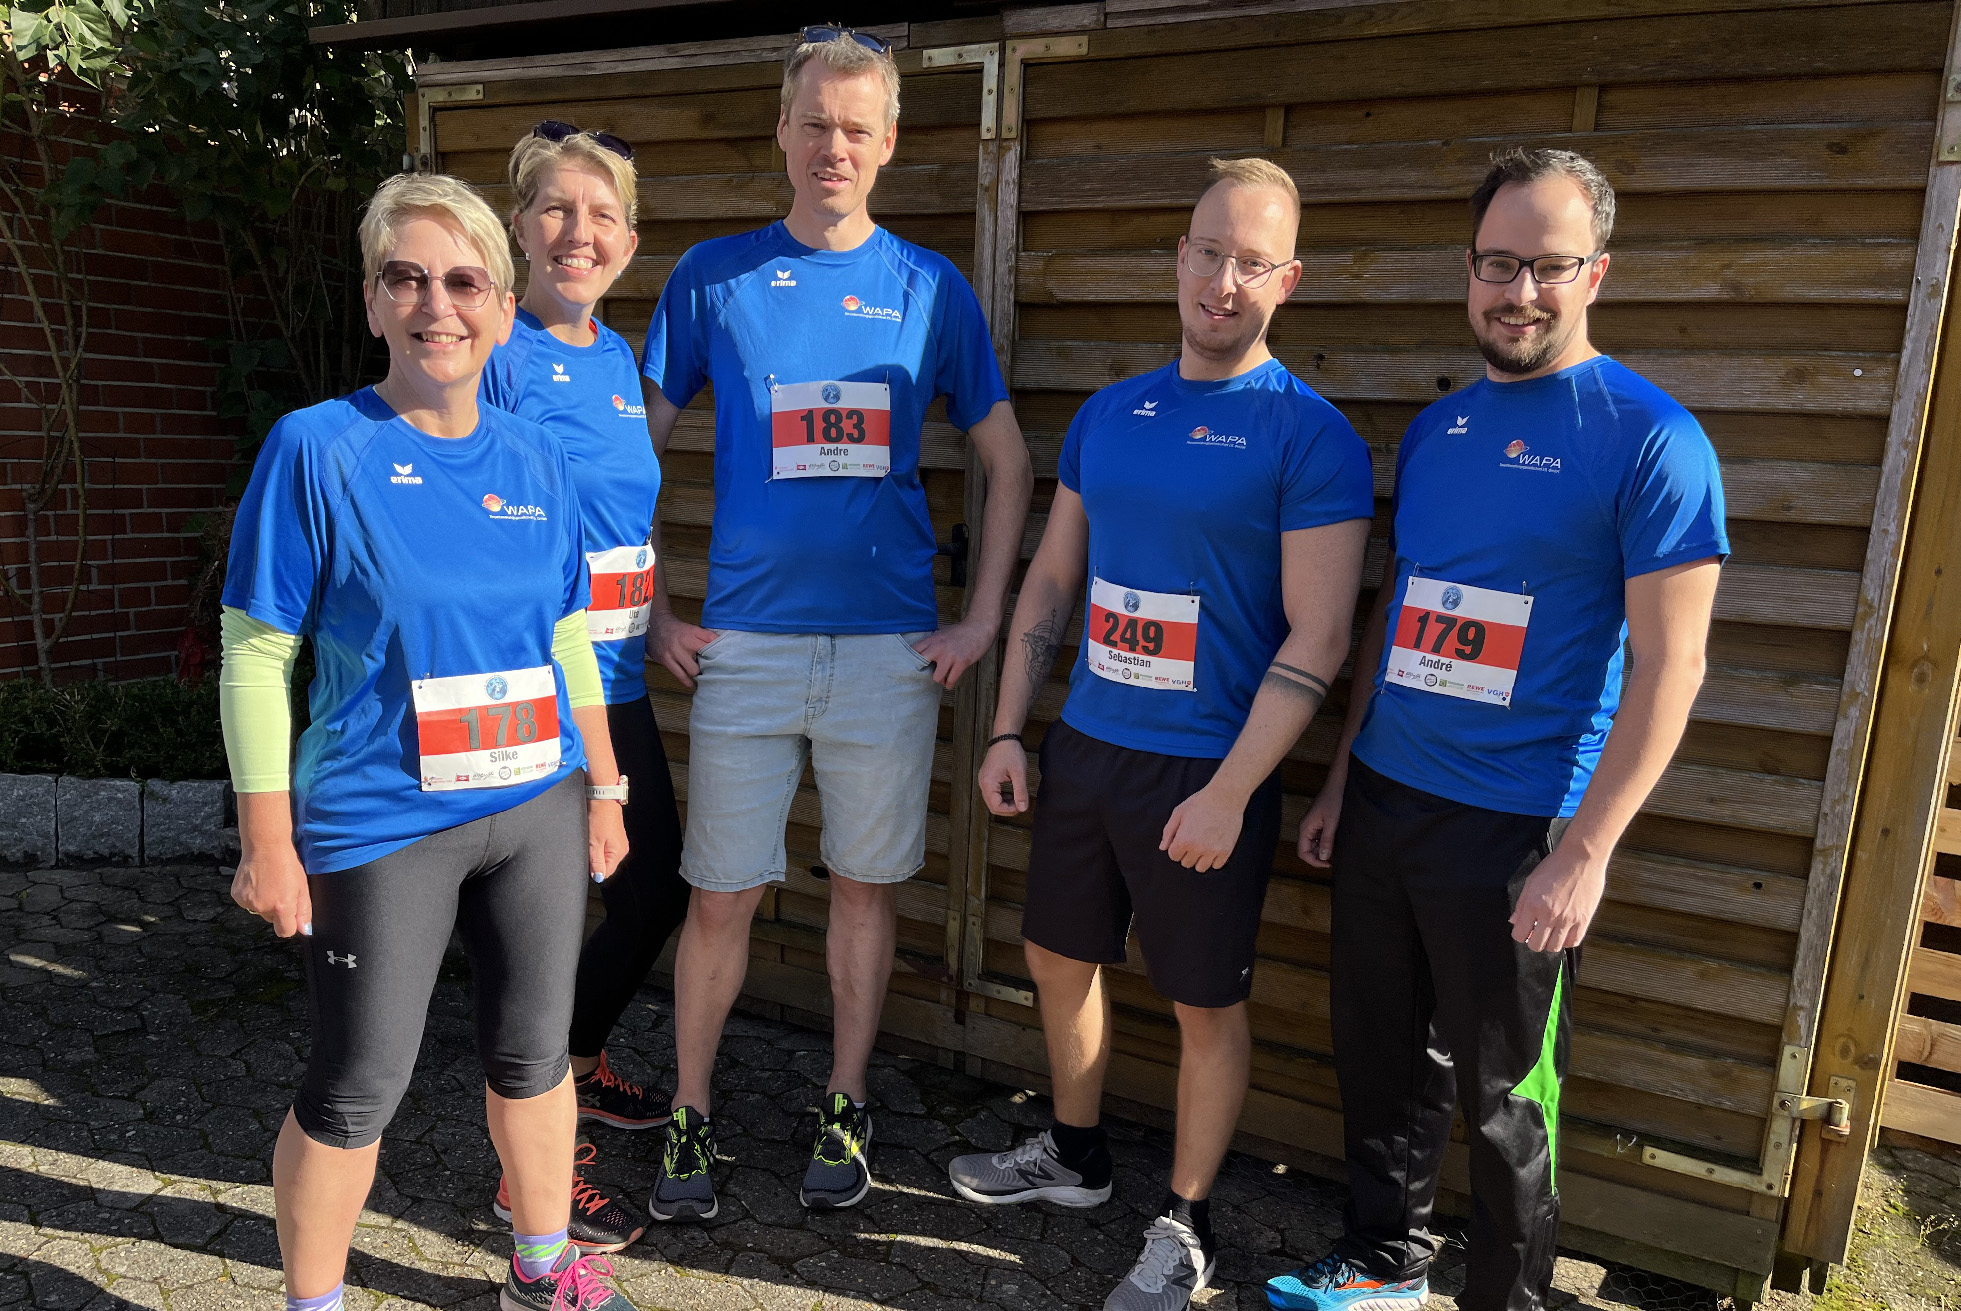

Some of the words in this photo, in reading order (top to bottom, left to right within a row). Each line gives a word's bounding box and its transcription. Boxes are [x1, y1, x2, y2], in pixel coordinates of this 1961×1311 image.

[861, 305, 901, 318] WAPA
[1133, 409, 1156, 417] erima
[800, 409, 866, 443] 183
[1447, 426, 1468, 435] erima
[1205, 434, 1247, 446] WAPA
[819, 446, 849, 457] Andre
[1519, 454, 1561, 469] WAPA
[390, 475, 423, 484] erima
[503, 505, 546, 517] WAPA
[1102, 612, 1164, 656] 249
[1413, 611, 1486, 661] 179
[1108, 650, 1151, 668] Sebastian
[1419, 655, 1453, 672] André
[1466, 684, 1485, 692] REWE
[1487, 688, 1504, 697] VGH
[459, 702, 537, 750] 178
[489, 750, 519, 764] Silke
